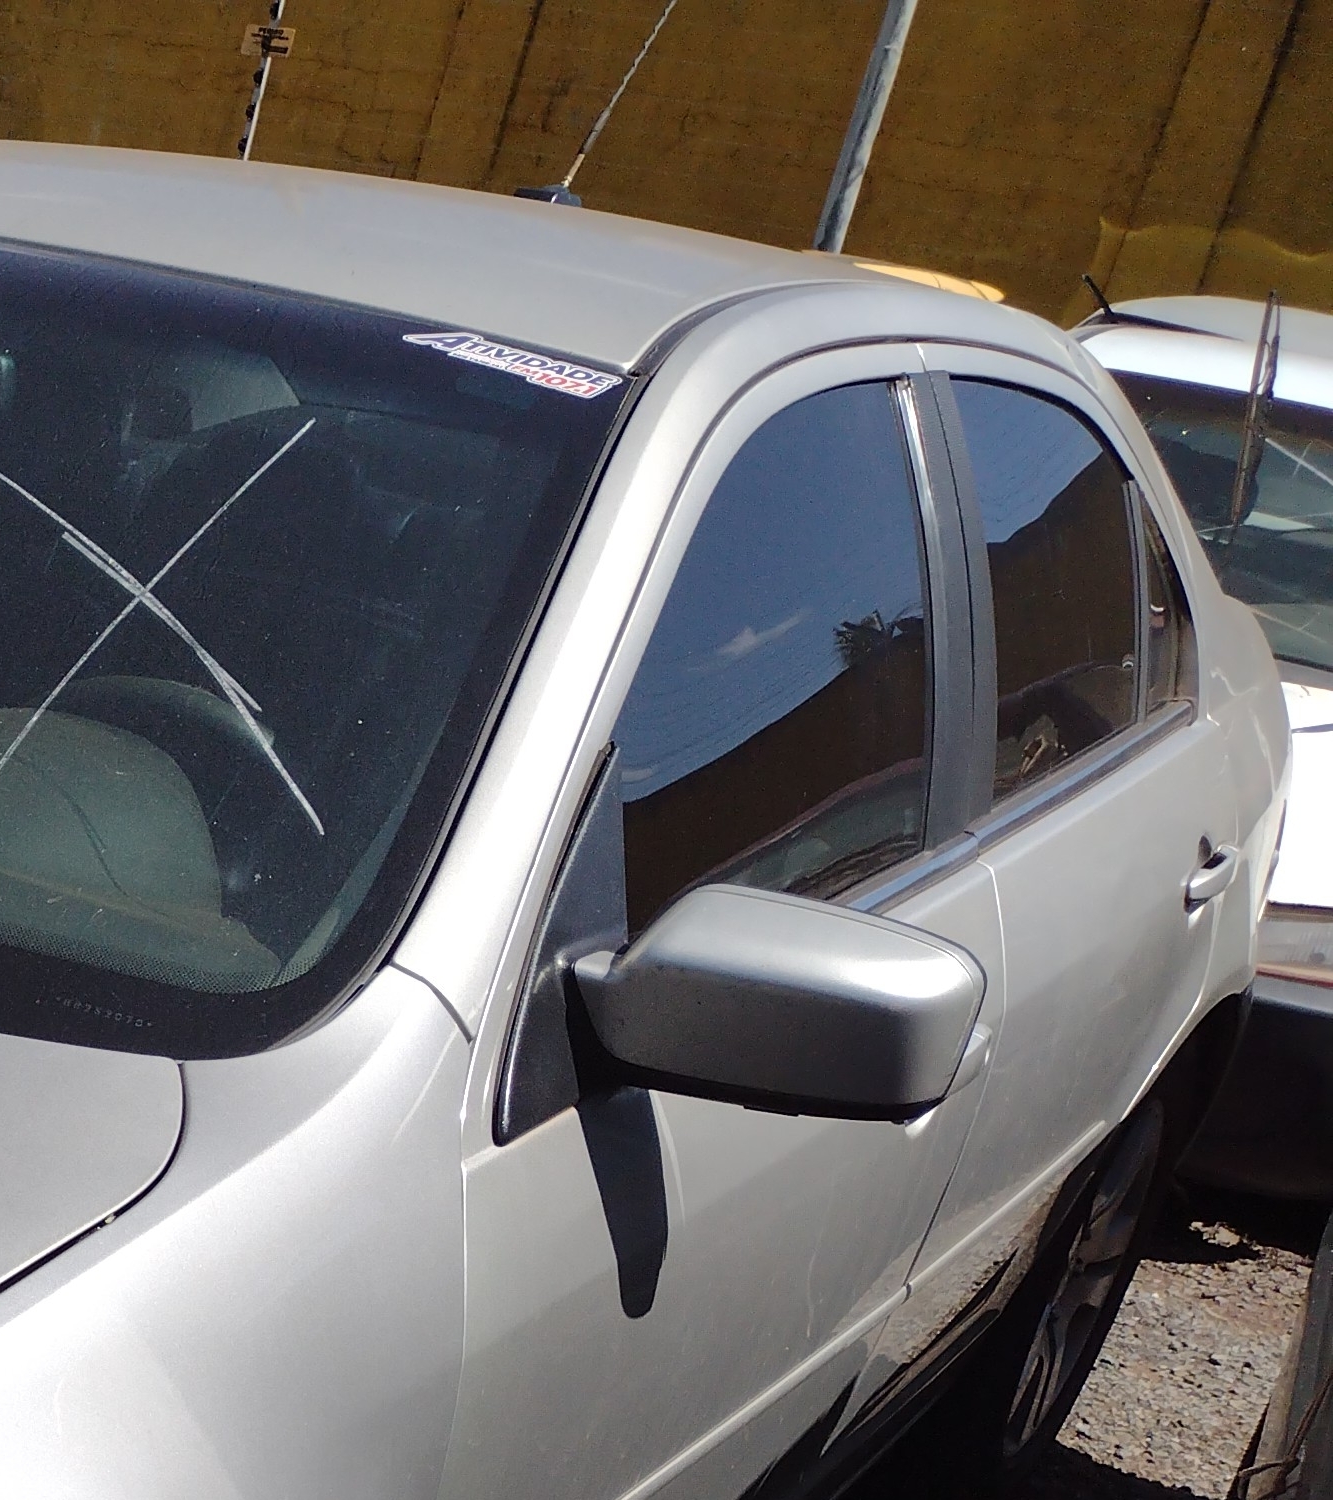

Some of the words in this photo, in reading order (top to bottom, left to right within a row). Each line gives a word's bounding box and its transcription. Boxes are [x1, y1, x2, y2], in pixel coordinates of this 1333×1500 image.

[411, 335, 612, 386] ATIVIDADE
[511, 364, 540, 377] FM
[534, 372, 597, 396] 107.1
